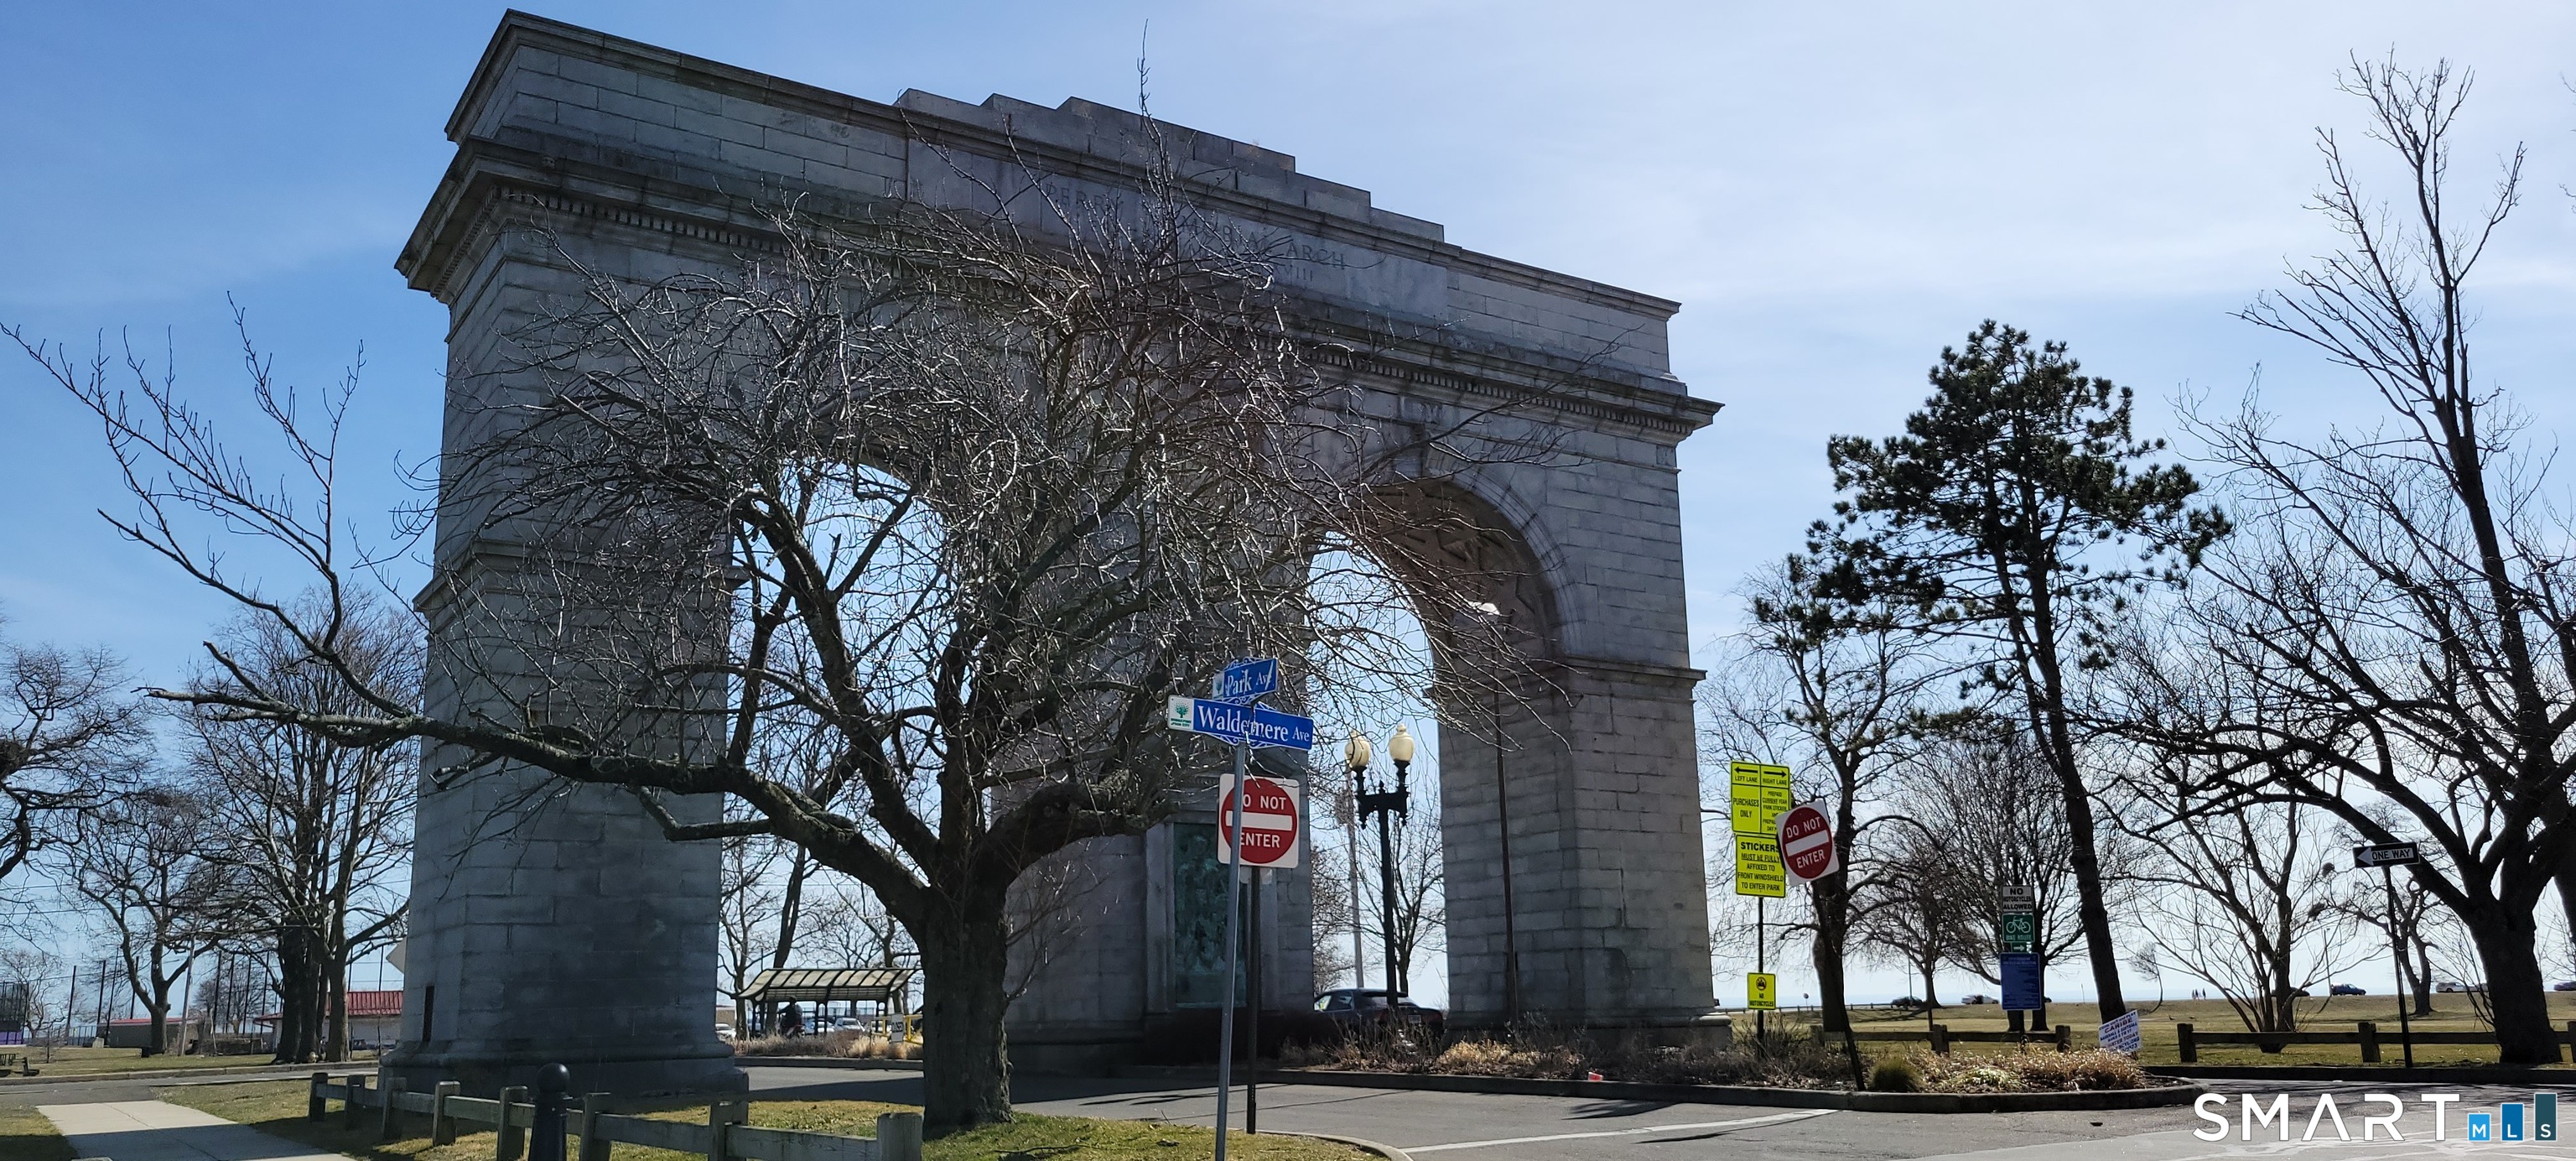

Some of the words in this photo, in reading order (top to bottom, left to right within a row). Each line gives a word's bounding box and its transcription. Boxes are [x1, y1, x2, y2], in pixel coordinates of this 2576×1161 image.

[1286, 242, 1345, 270] ARCH
[1227, 669, 1252, 697] Park
[1197, 705, 1289, 742] Waldemere
[1292, 726, 1310, 742] Ave
[1243, 794, 1252, 808] O
[1259, 795, 1286, 810] NOT
[1733, 798, 1759, 807] PURCHASES
[1740, 810, 1752, 818] ONLY
[1786, 825, 1800, 839] DO
[1803, 816, 1820, 833] NOT
[1742, 852, 1756, 861] MUST
[1796, 849, 1826, 869] ENTER
[2371, 851, 2390, 861] ONE
[2392, 848, 2411, 858] WAY
[1754, 873, 1784, 882] WINDSHIELD
[2105, 1018, 2133, 1033] CARIBE
